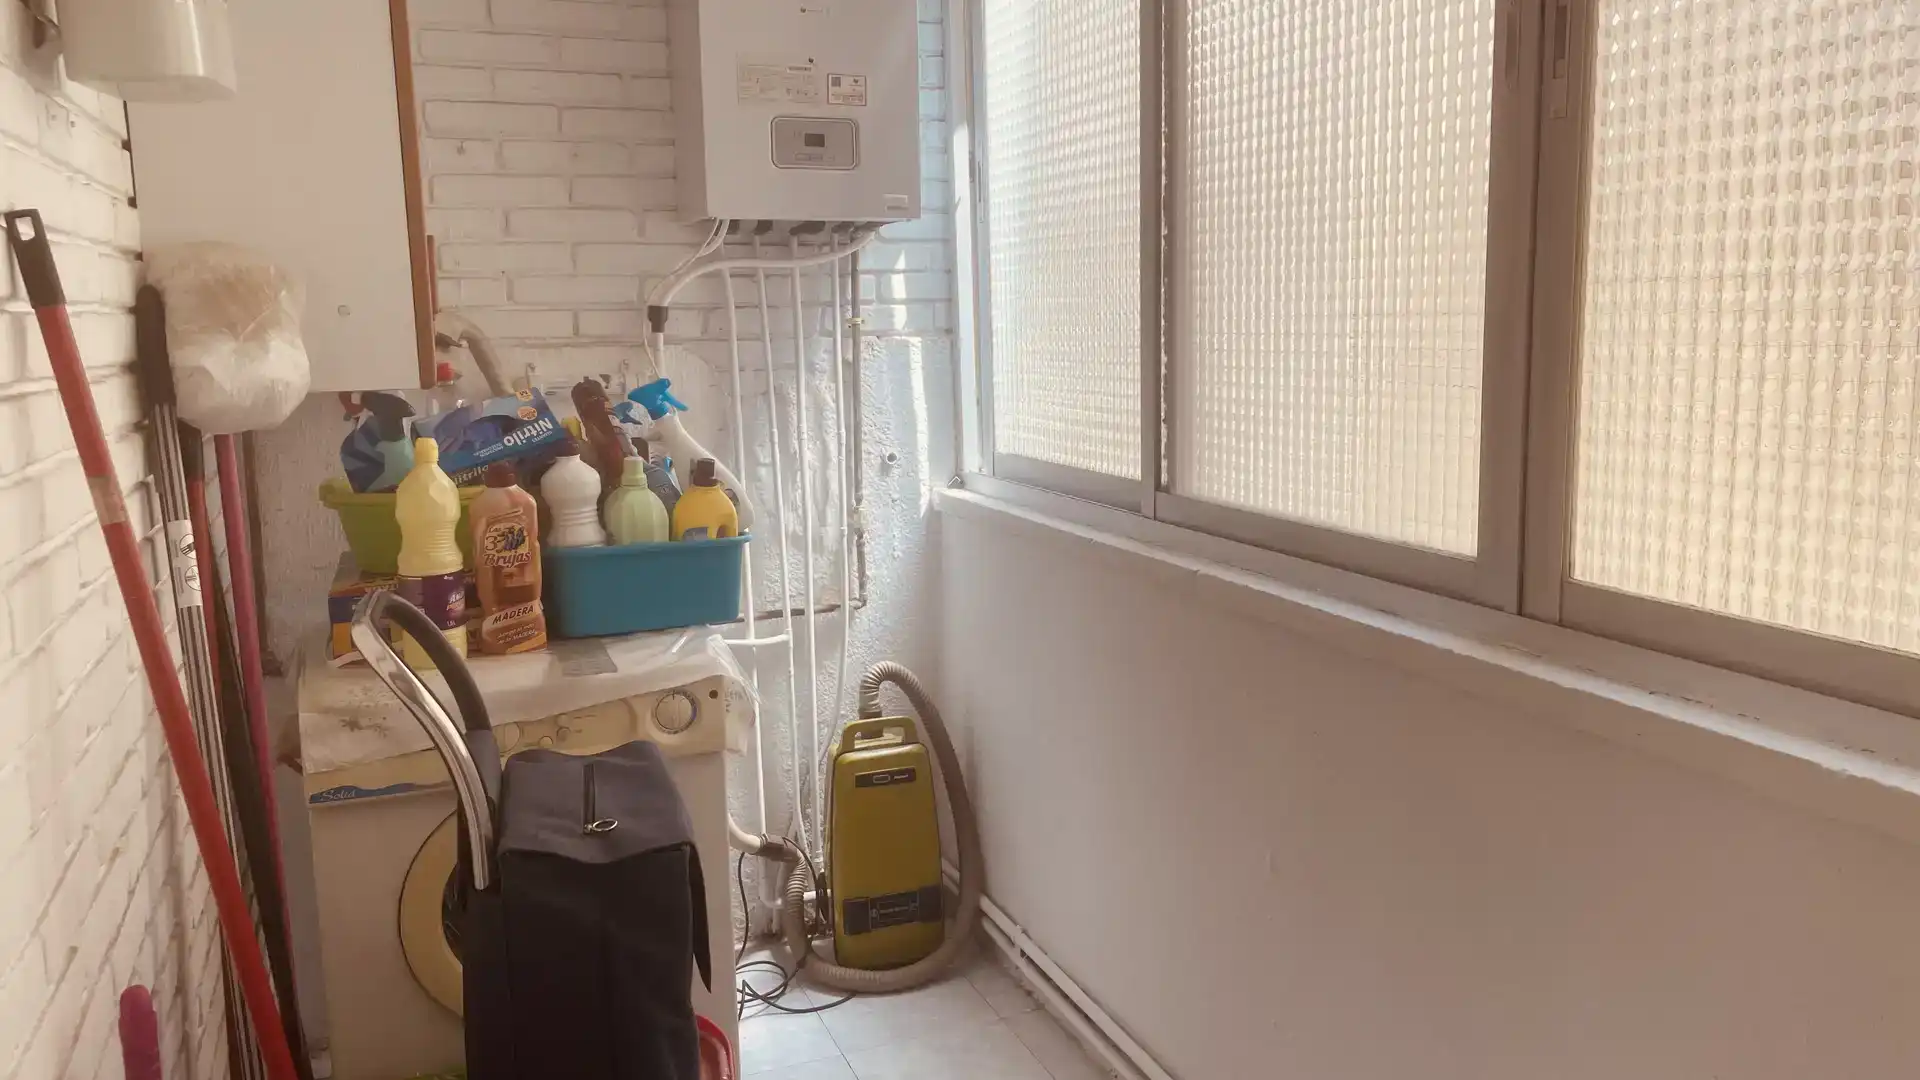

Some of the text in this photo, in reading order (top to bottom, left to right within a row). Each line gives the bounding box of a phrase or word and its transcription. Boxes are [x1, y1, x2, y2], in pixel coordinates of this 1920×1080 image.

[503, 418, 554, 446] Nitrilo
[486, 536, 497, 550] 3
[484, 551, 532, 568] Brujas
[492, 604, 534, 625] MADERA
[320, 789, 356, 801] Solid
